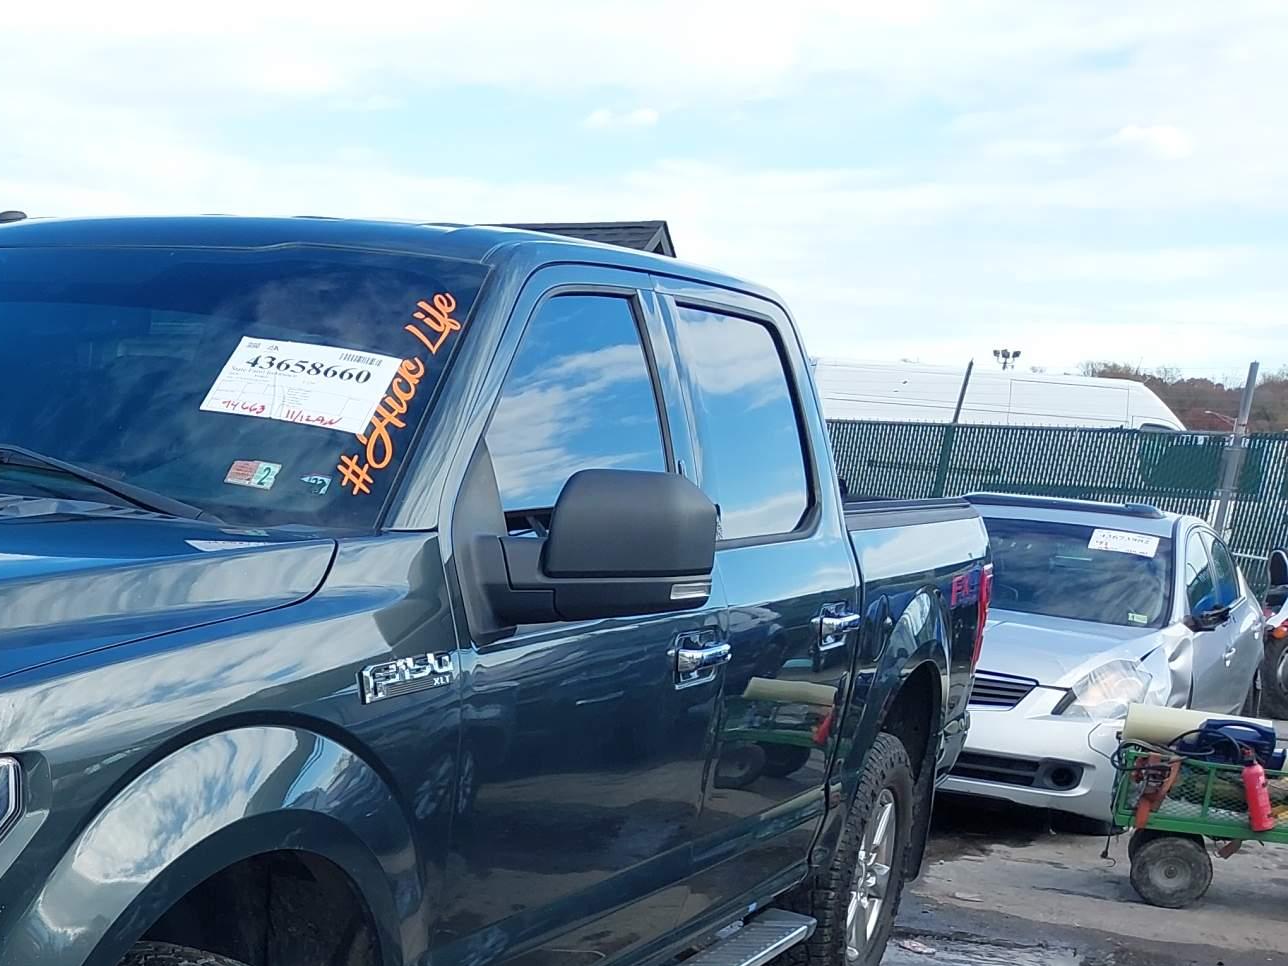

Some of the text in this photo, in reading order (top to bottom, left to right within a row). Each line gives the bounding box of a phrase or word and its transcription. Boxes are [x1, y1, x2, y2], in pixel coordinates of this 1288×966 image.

[404, 292, 462, 355] Life
[245, 354, 373, 384] 43658660
[257, 466, 272, 486] 2
[433, 675, 450, 686] XLT
